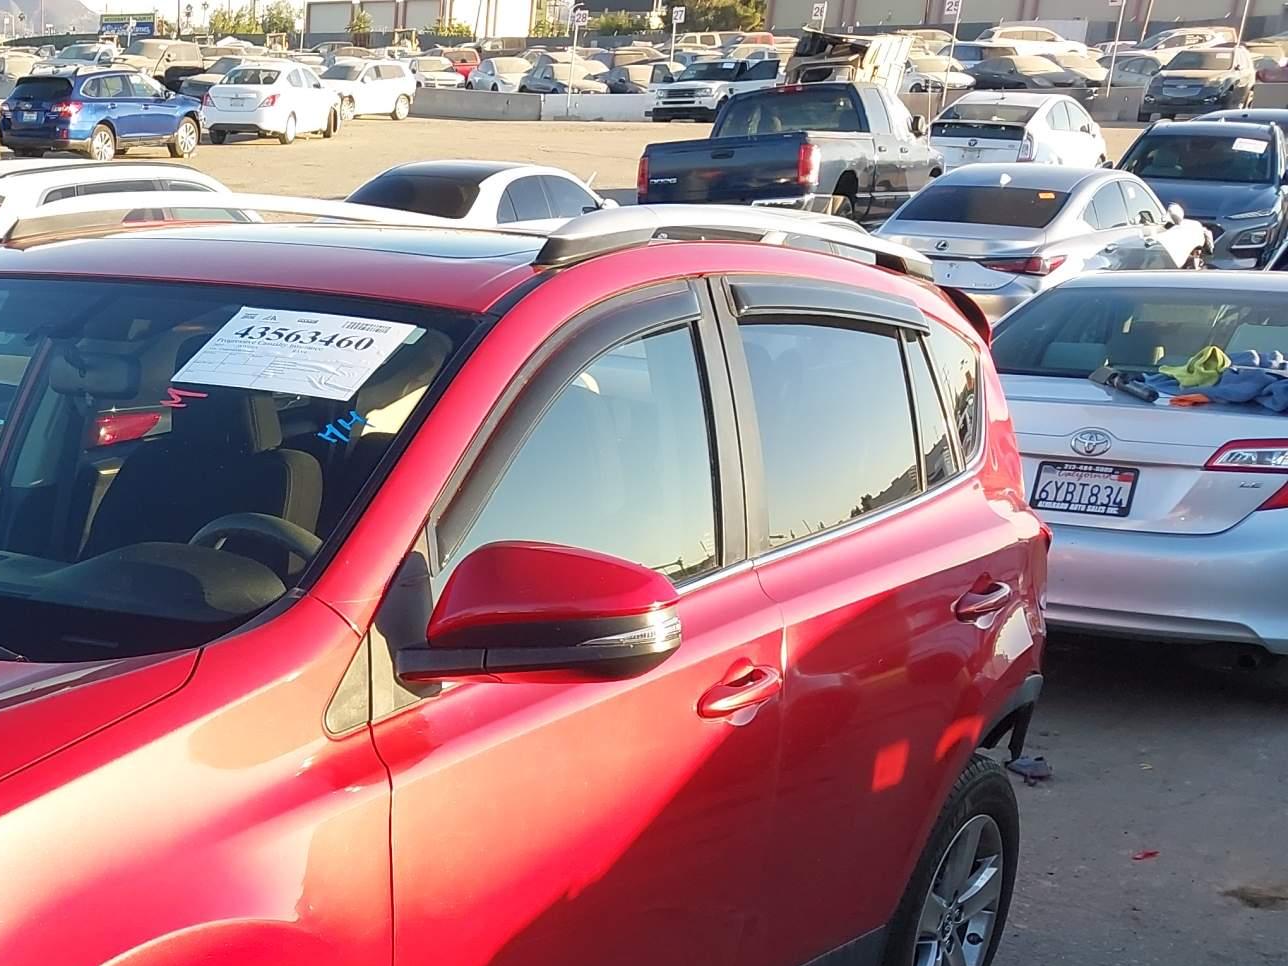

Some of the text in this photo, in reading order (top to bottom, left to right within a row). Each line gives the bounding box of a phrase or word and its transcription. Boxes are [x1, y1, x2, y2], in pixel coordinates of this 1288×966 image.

[576, 13, 587, 22] 28
[673, 10, 684, 20] 27
[234, 325, 374, 351] 43563460
[1039, 480, 1124, 507] 6YBT834
